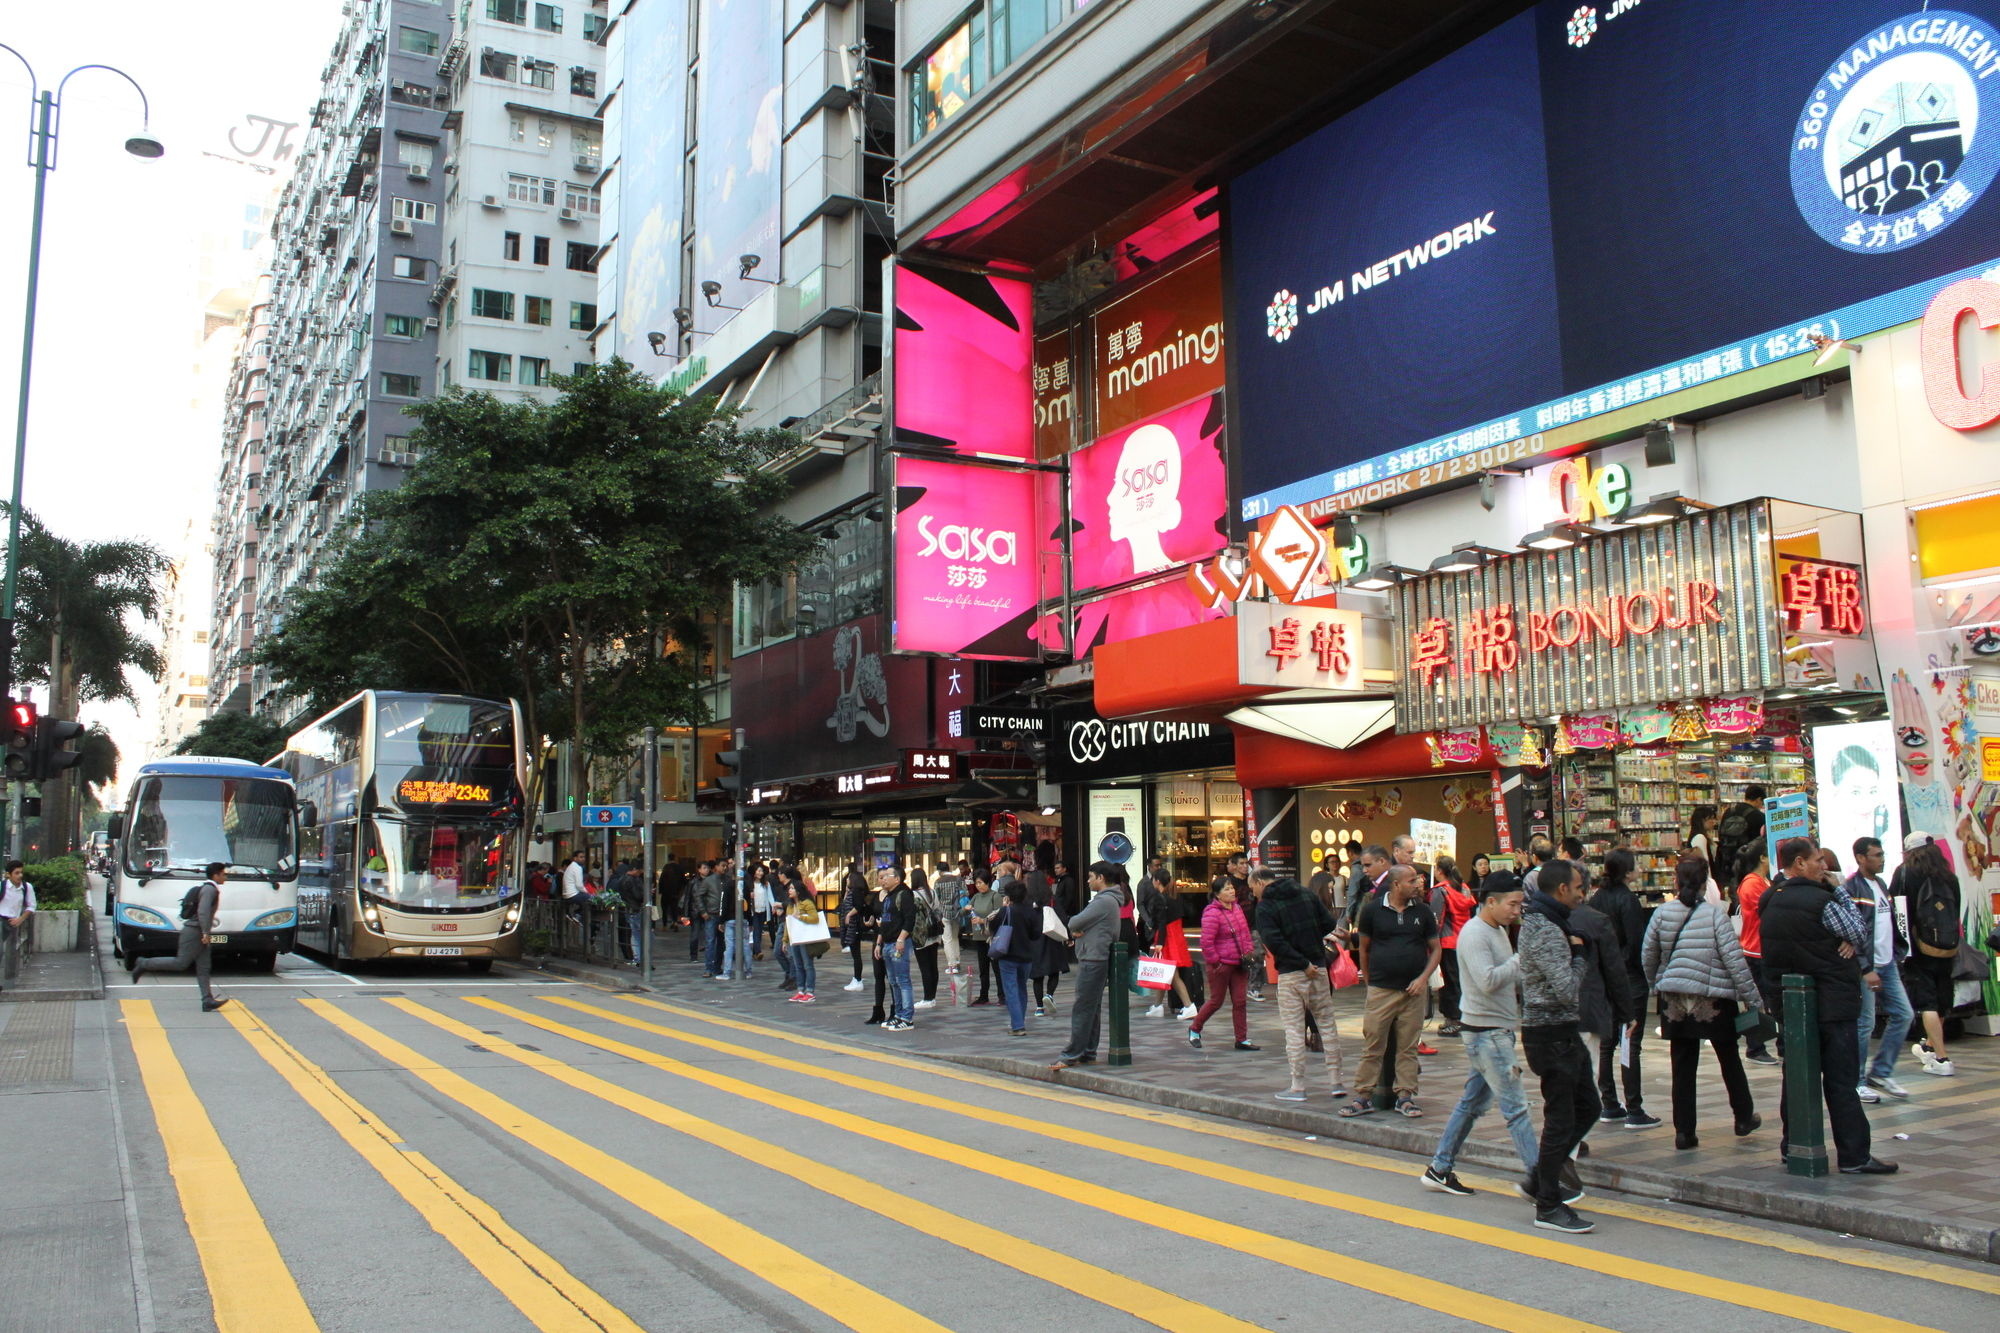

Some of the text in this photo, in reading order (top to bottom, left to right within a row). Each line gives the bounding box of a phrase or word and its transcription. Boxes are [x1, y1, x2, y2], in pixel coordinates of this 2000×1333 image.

[1840, 180, 1973, 248] 全方位管理
[1307, 211, 1497, 314] JM NETWORK
[1108, 321, 1143, 364] 萬寧
[1310, 473, 1413, 518] NETWORK
[947, 565, 988, 589] 莎莎
[1781, 562, 1864, 635] 卓悅
[923, 592, 1012, 613] making life beautiful
[1529, 578, 1724, 652] BONJOUR
[1266, 617, 1351, 675] 卓悅
[1411, 603, 1520, 687] 卓悅
[949, 657, 961, 738] 大福
[1977, 683, 1998, 704] Cke
[979, 716, 1043, 730] CITY CHAIN
[1111, 721, 1148, 749] CITY
[1154, 721, 1210, 744] CHAIN
[913, 754, 949, 768] 周大福
[1164, 796, 1200, 805] SUUNTO
